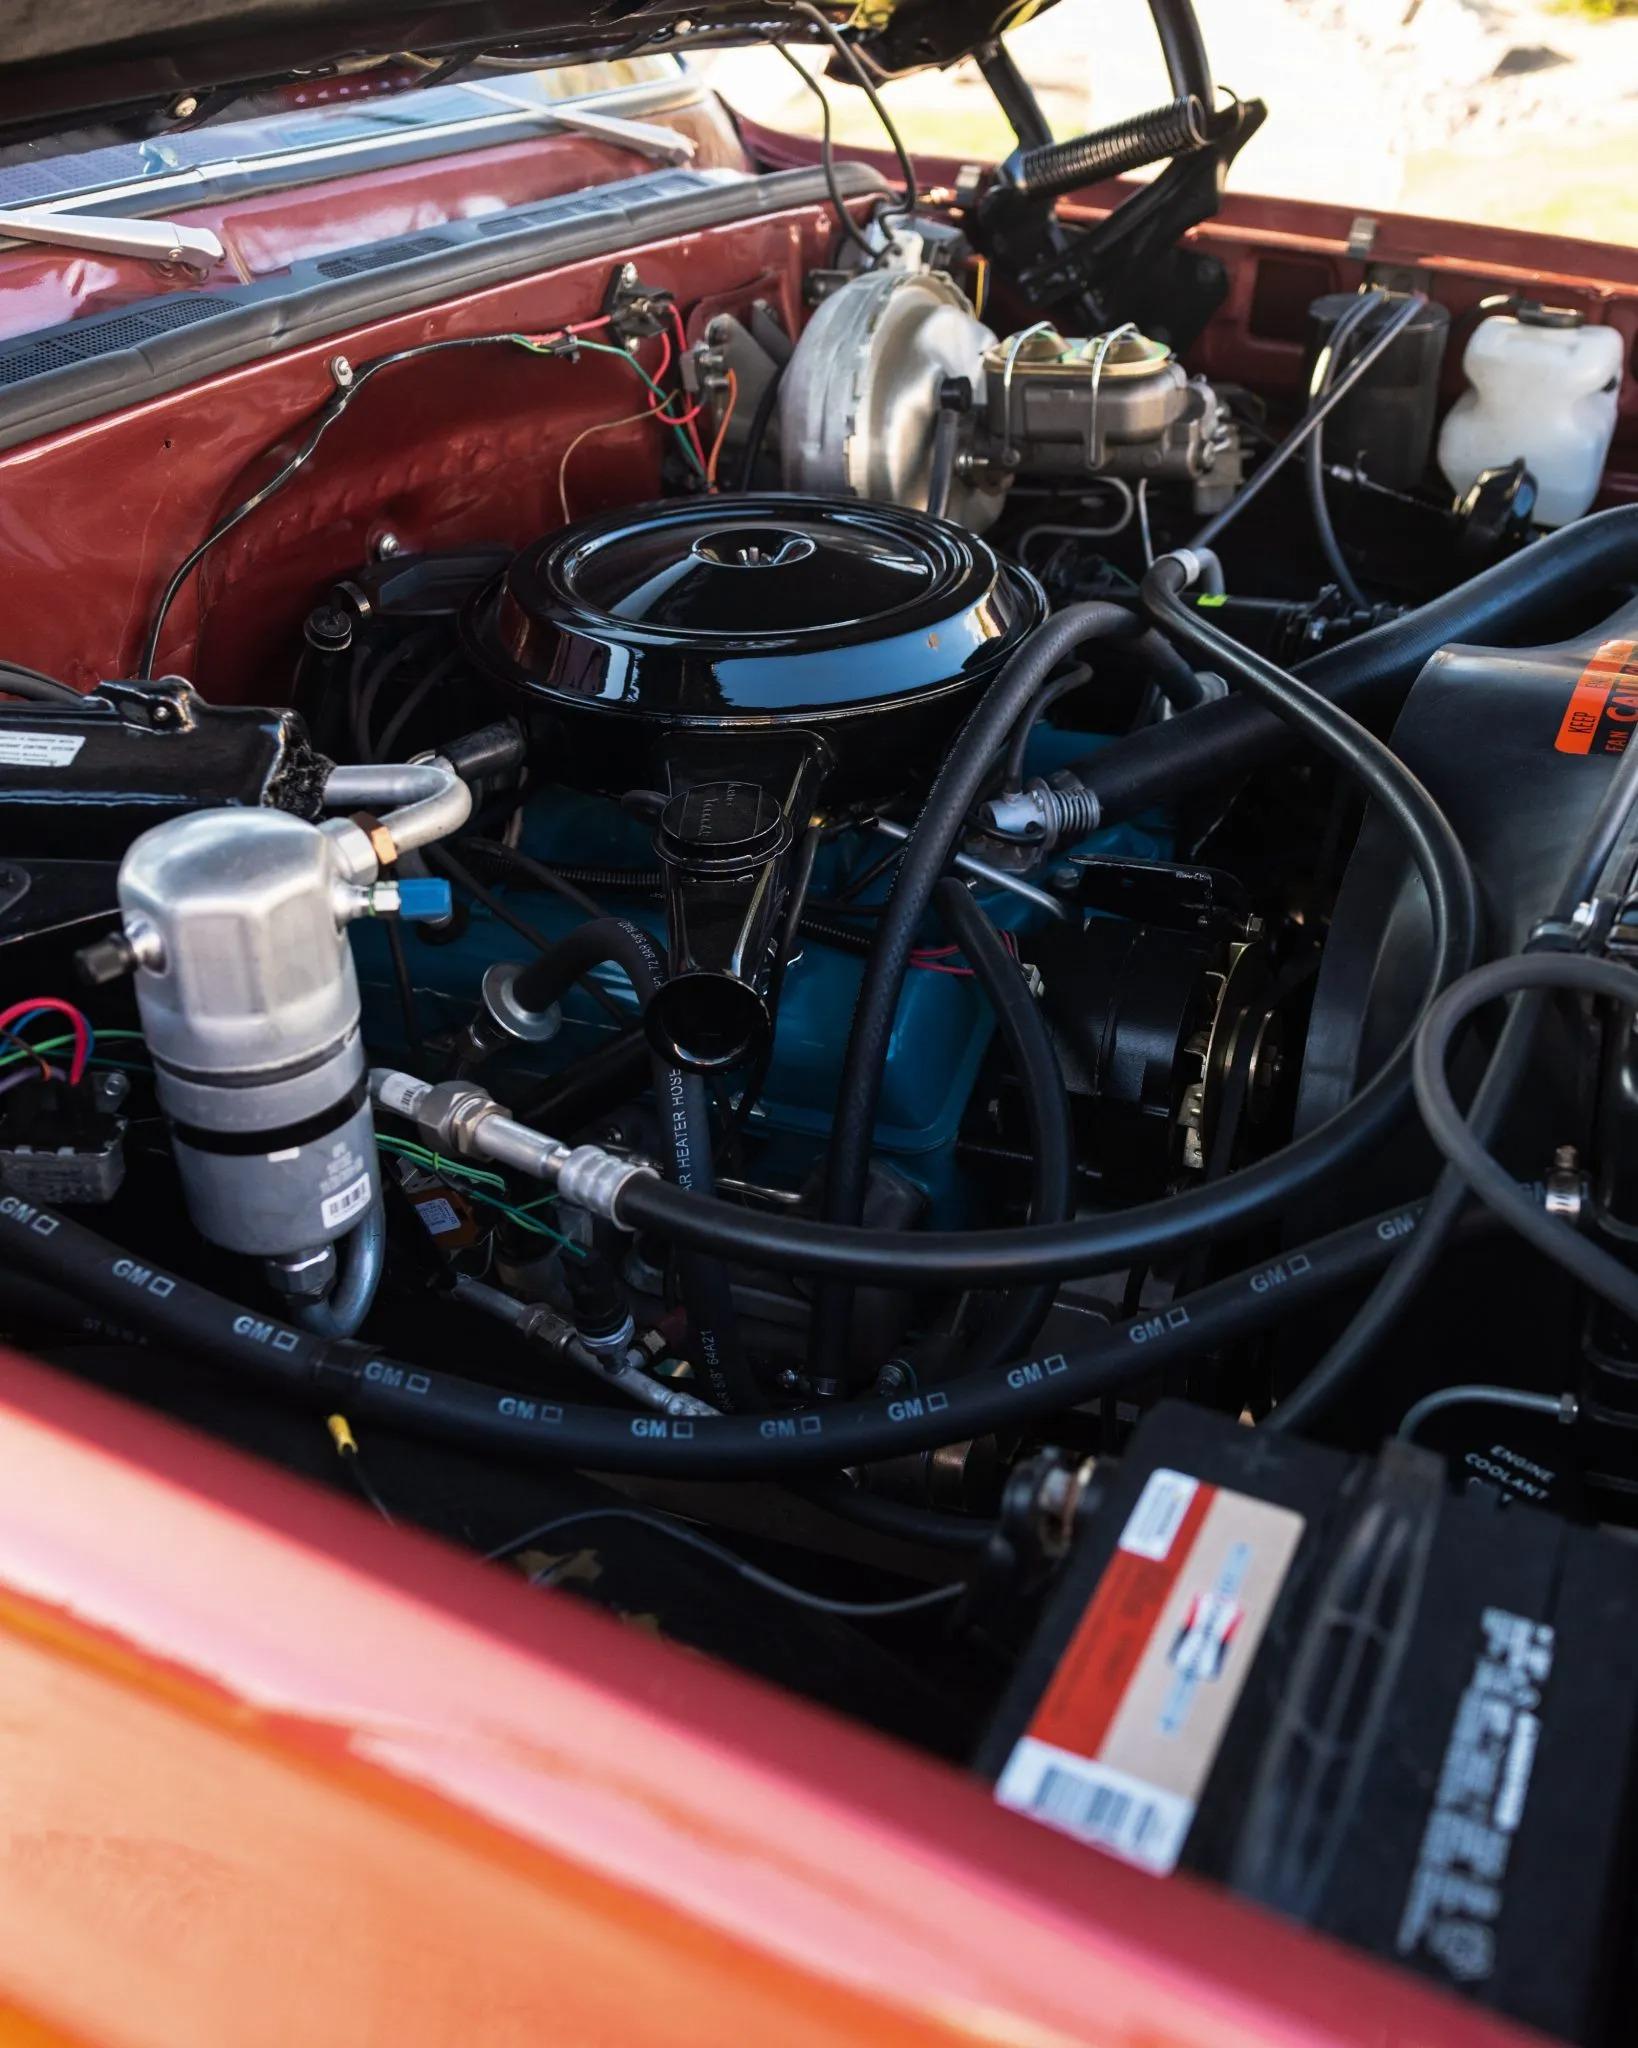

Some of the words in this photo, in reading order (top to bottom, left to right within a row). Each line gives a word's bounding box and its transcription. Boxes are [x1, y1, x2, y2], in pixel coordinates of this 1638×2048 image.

[1567, 711, 1596, 734] KEEP
[1604, 731, 1629, 753] FAN
[668, 1068, 684, 1107] HOSE
[672, 1110, 690, 1169] HEATER
[0, 1196, 37, 1223] GM
[1376, 1215, 1415, 1241] GM
[112, 1259, 152, 1286] GM
[1250, 1265, 1287, 1293] GM
[232, 1315, 275, 1343] GM
[1129, 1316, 1165, 1344] GM
[364, 1361, 403, 1387] GM
[1007, 1362, 1043, 1389] GM
[498, 1397, 536, 1421] GM
[888, 1397, 924, 1422] GM
[631, 1418, 667, 1439] GM
[760, 1418, 796, 1440] GM
[1464, 1452, 1551, 1500] COOLANT
[1490, 1444, 1555, 1482] ENGINE
